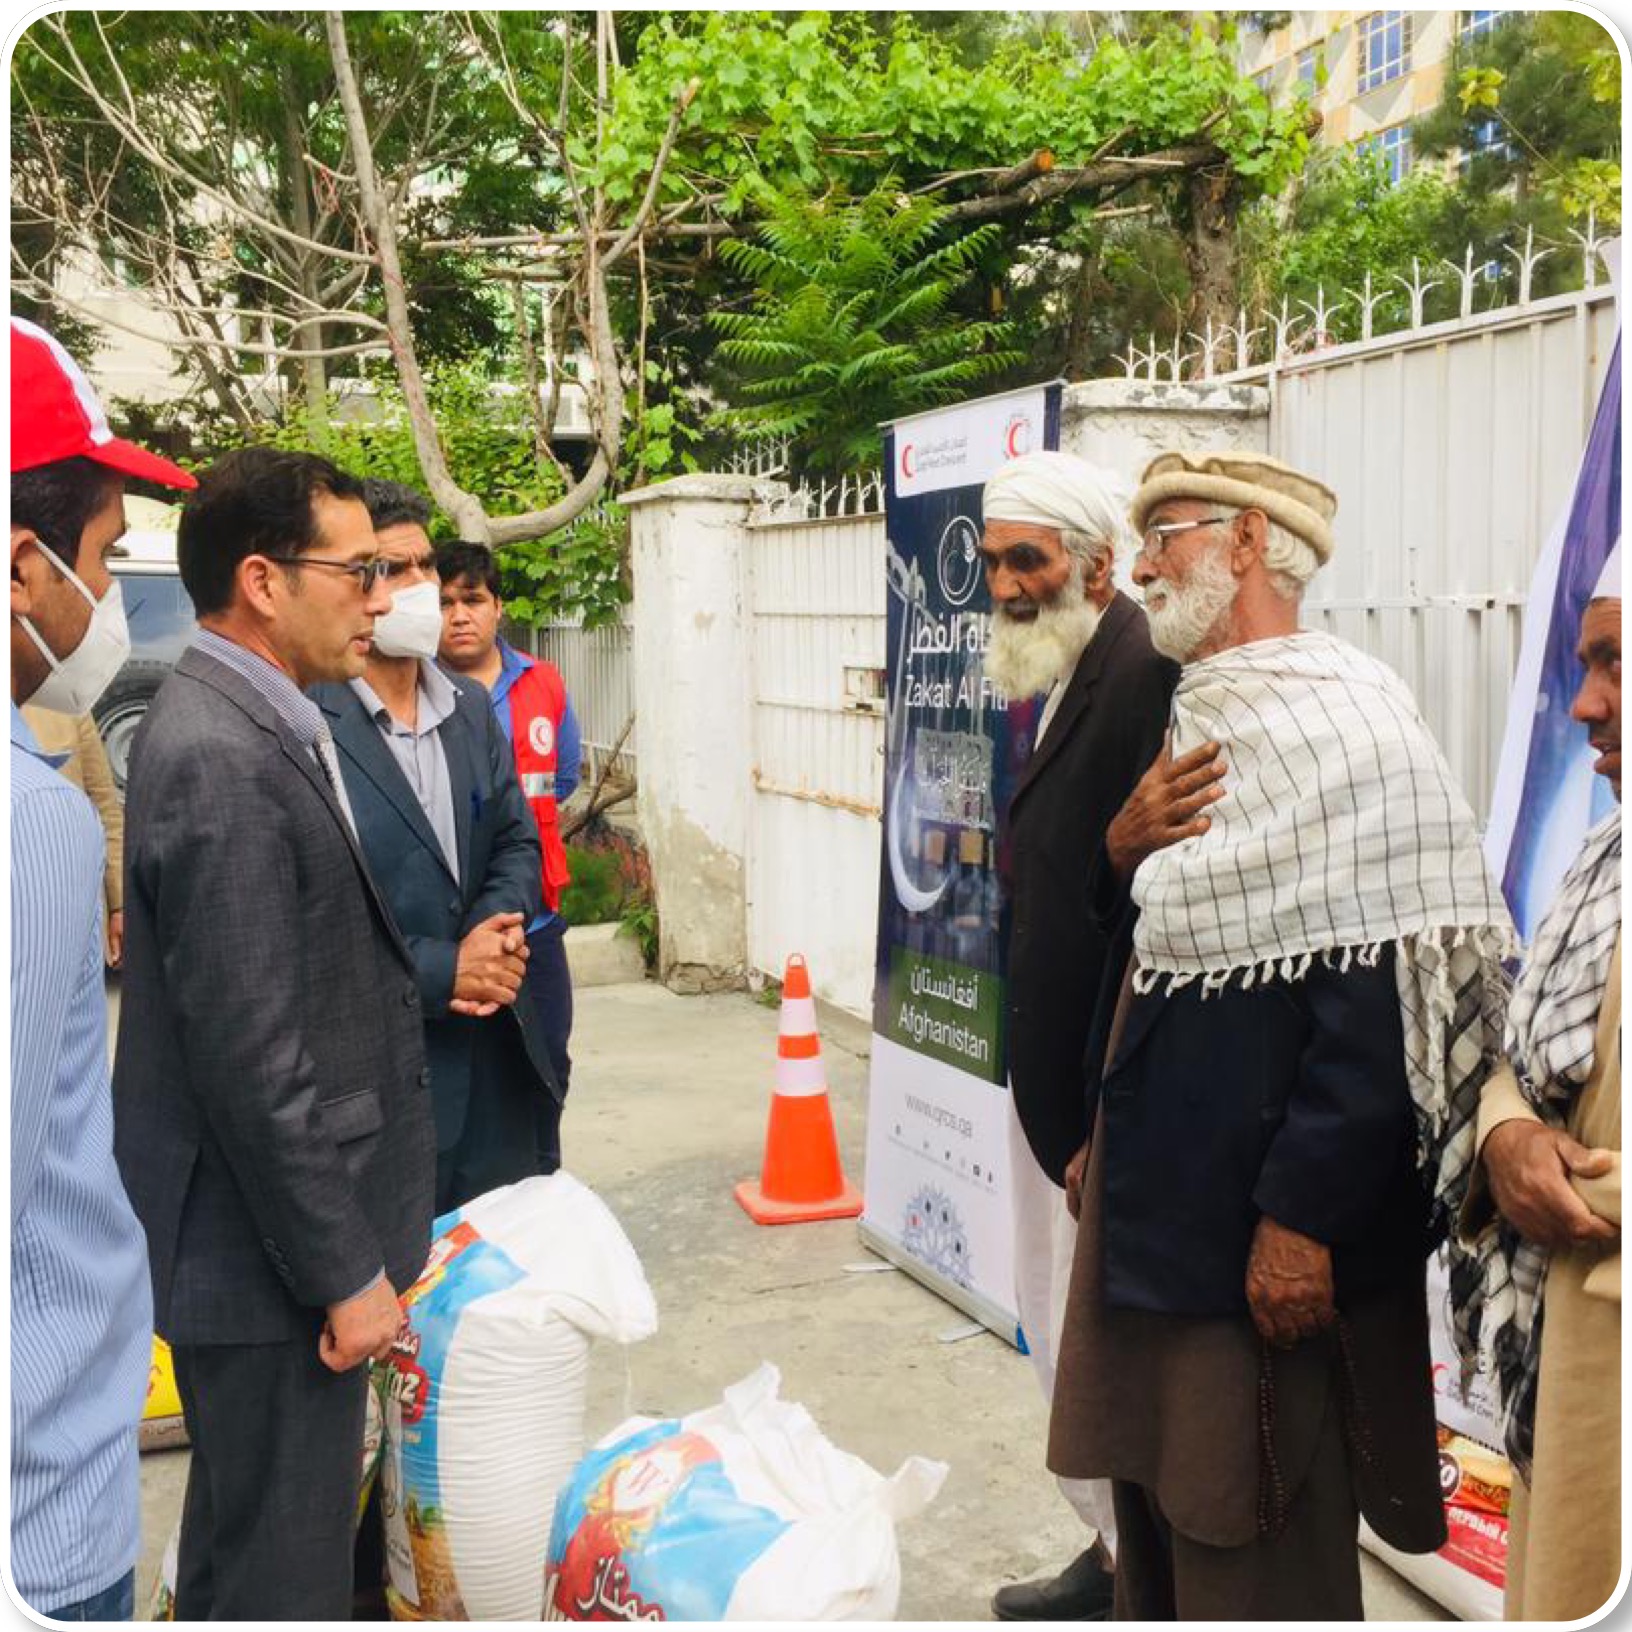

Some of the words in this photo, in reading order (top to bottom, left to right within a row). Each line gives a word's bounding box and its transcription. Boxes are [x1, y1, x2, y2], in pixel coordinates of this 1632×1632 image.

[904, 674, 952, 709] Zakat
[956, 676, 975, 709] Al
[898, 1003, 989, 1063] Afghanistan
